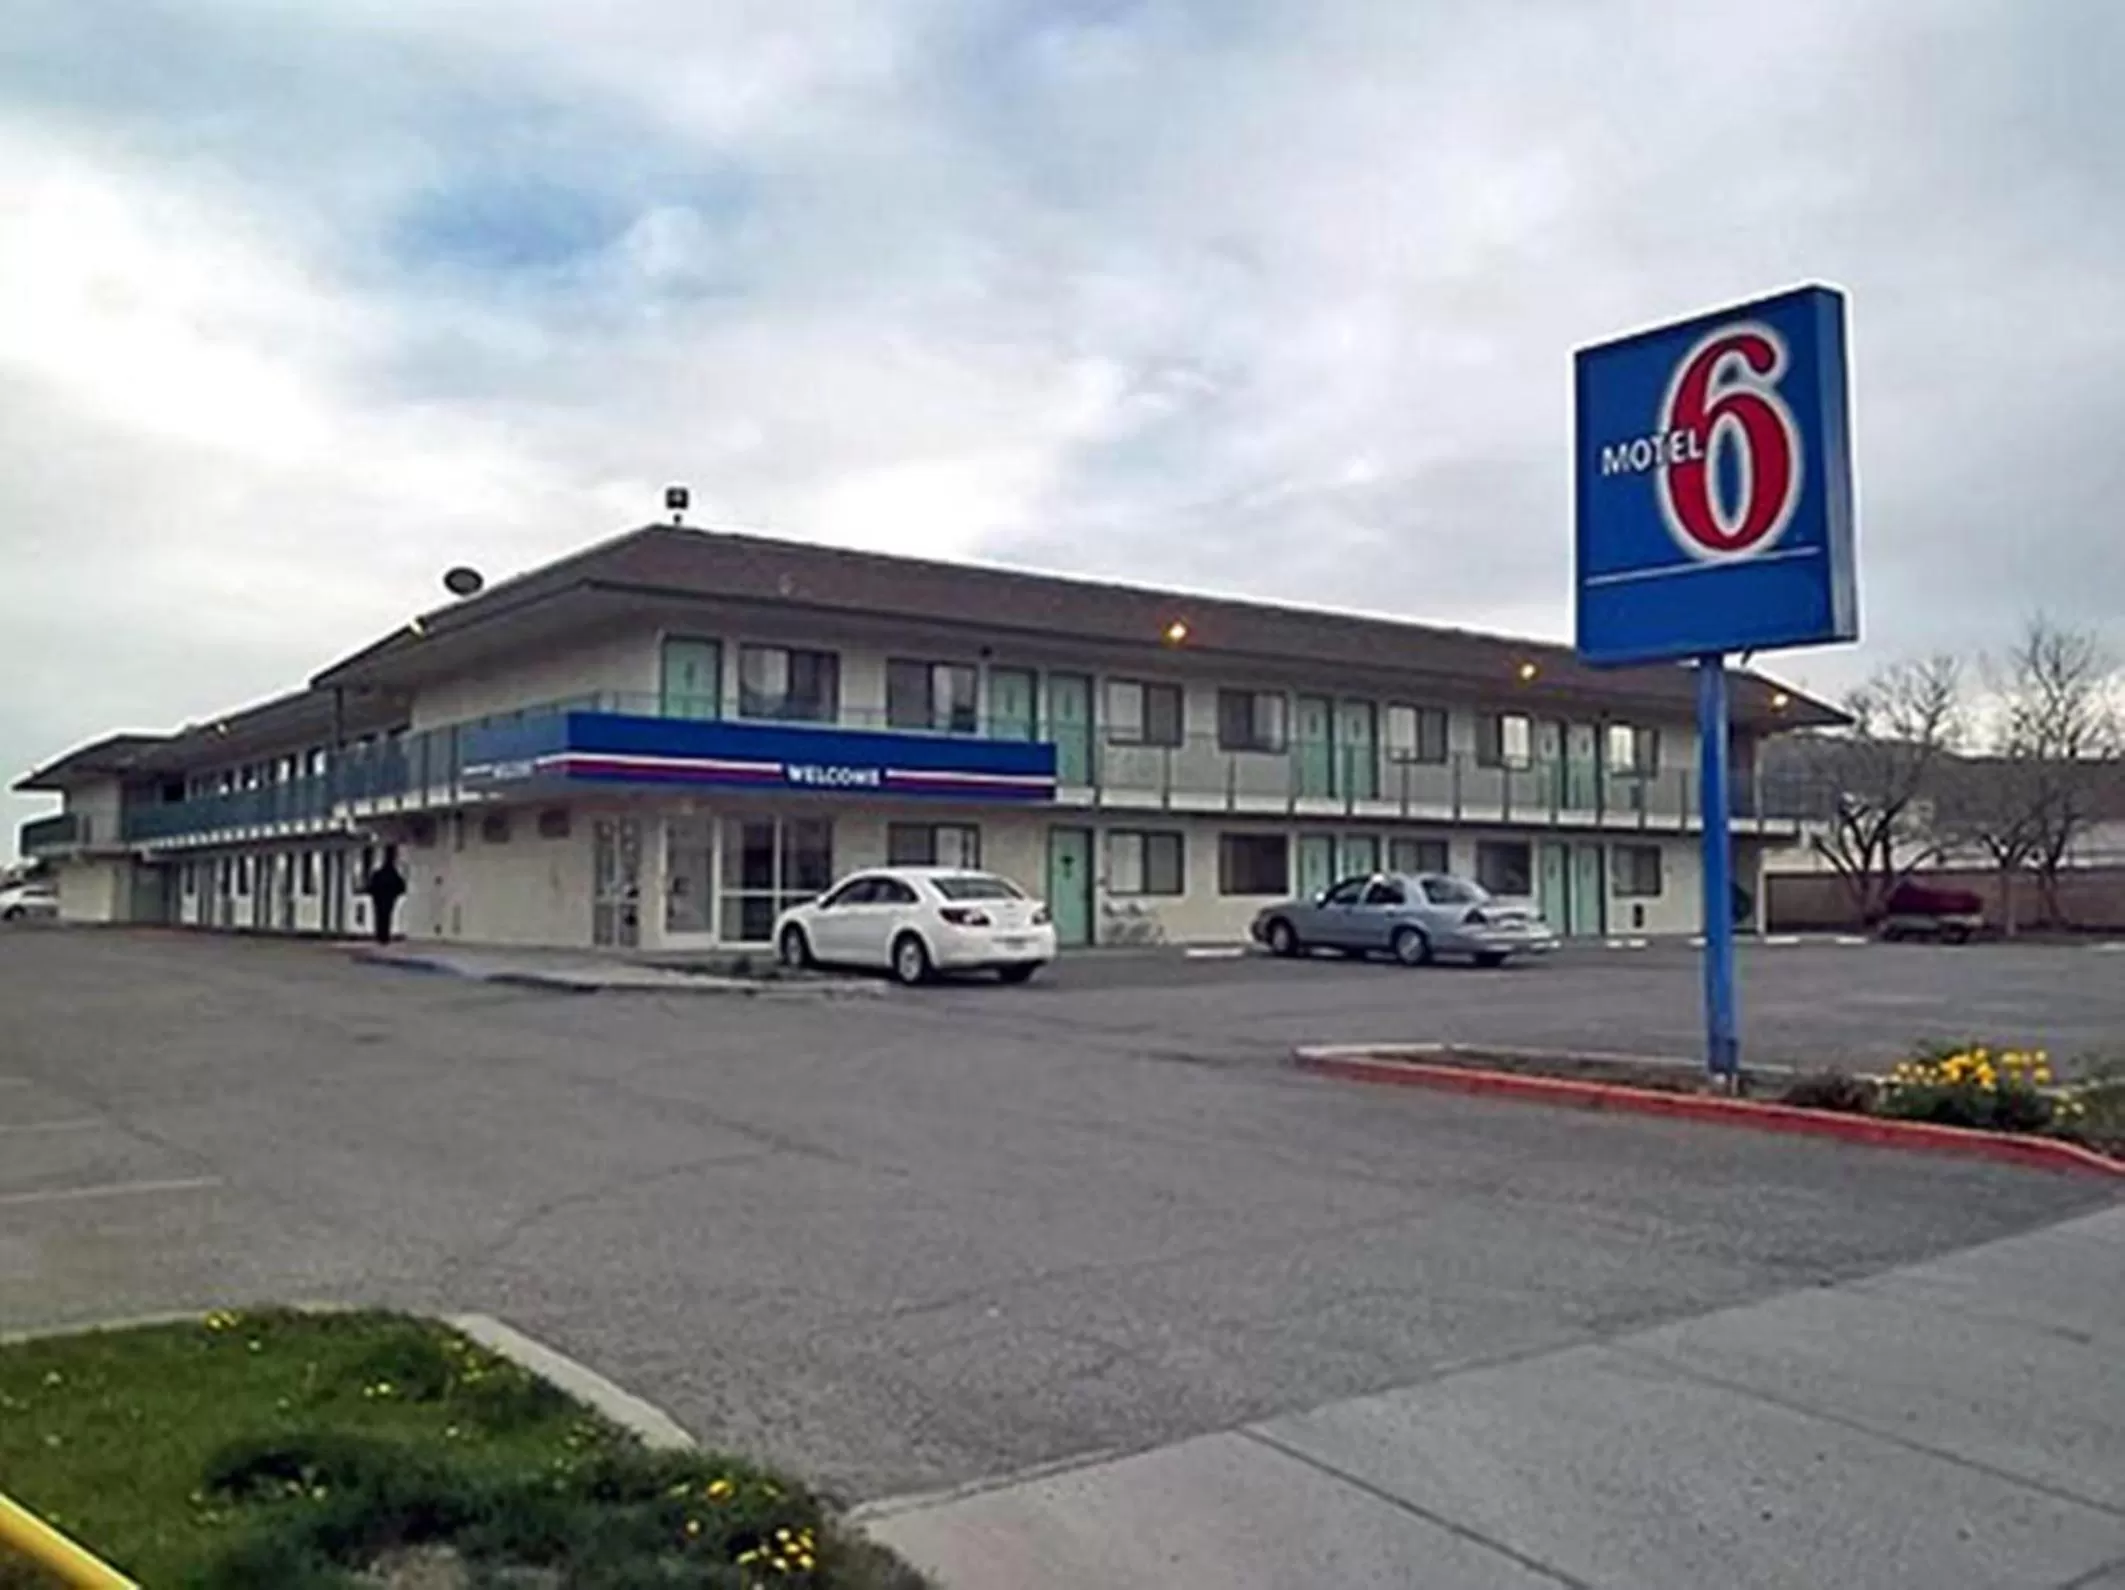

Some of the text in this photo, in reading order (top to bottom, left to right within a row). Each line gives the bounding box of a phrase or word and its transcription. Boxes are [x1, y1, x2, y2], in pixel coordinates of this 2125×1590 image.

[1602, 325, 1801, 558] MOTEL 6
[787, 764, 880, 787] WELCOME
